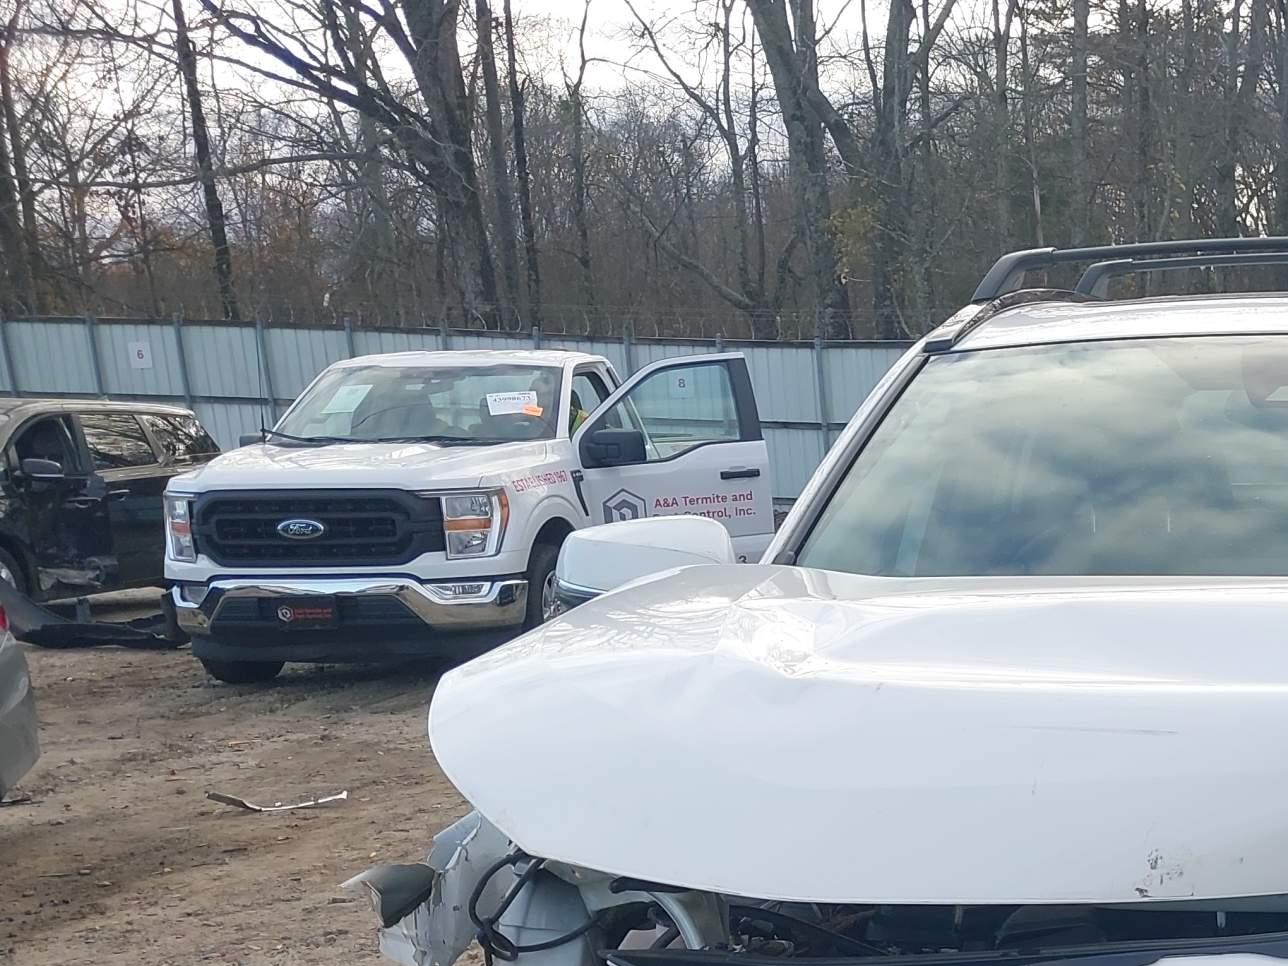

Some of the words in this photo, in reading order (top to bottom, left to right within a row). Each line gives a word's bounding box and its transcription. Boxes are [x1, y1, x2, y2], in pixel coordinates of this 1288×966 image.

[136, 349, 144, 360] 6
[678, 378, 686, 388] 8
[654, 497, 679, 508] A&A
[681, 493, 728, 506] Termite
[731, 490, 753, 501] and
[735, 507, 756, 516] Inc.
